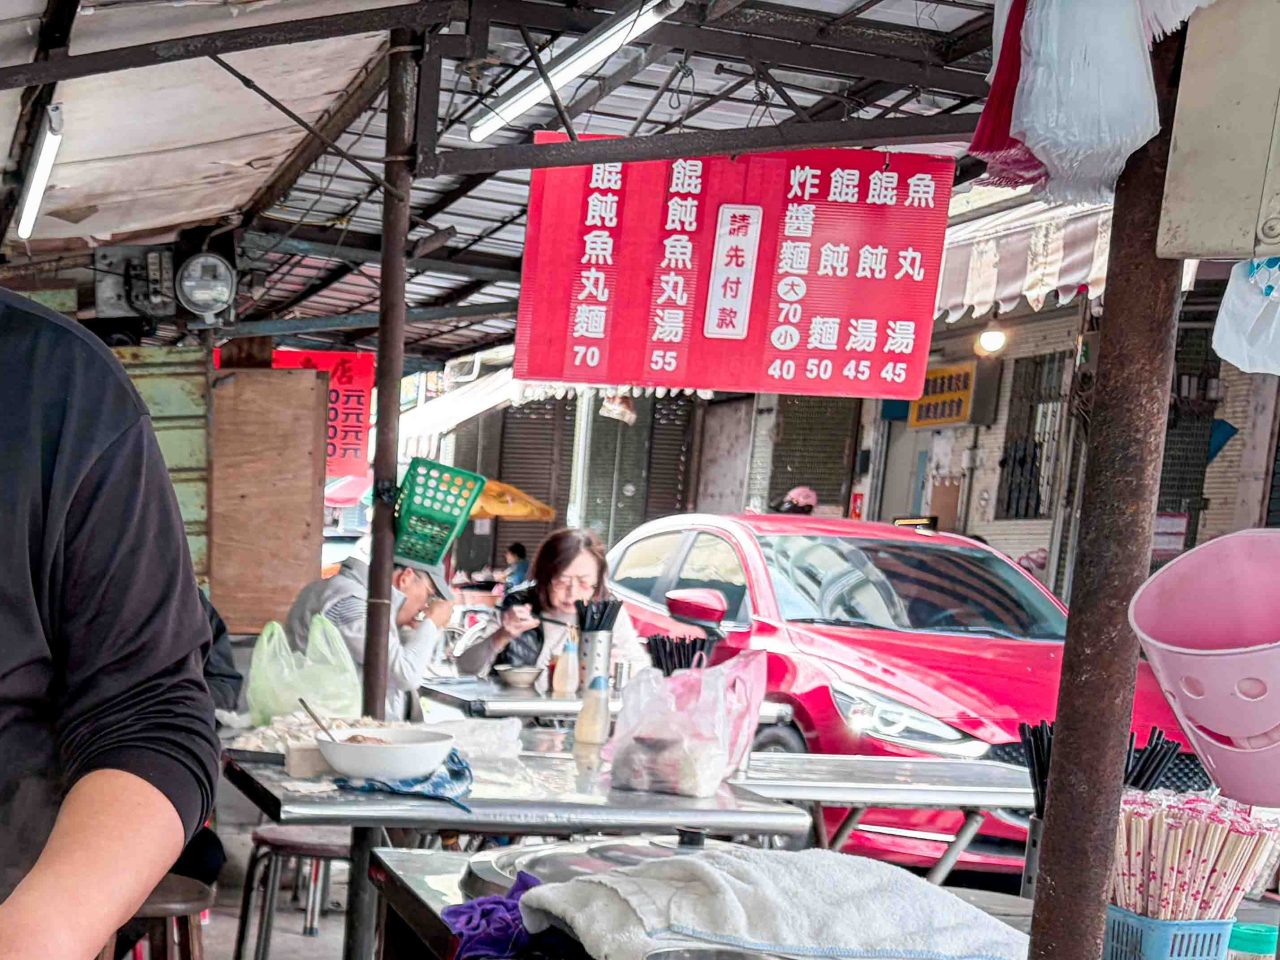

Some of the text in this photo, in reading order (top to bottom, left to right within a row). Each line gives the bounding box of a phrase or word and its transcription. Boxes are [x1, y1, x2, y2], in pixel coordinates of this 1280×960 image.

[650, 158, 702, 371] 餛飩魚丸湯 55
[716, 213, 751, 329] 請先付款
[777, 165, 821, 275] 炸醬麵
[806, 168, 860, 380] 餛飩麵 50
[843, 170, 898, 380] 餛飩湯 45
[778, 302, 802, 323] 70
[880, 174, 935, 383] 魚丸湯 45
[573, 346, 600, 366] 70
[768, 359, 795, 379] 40
